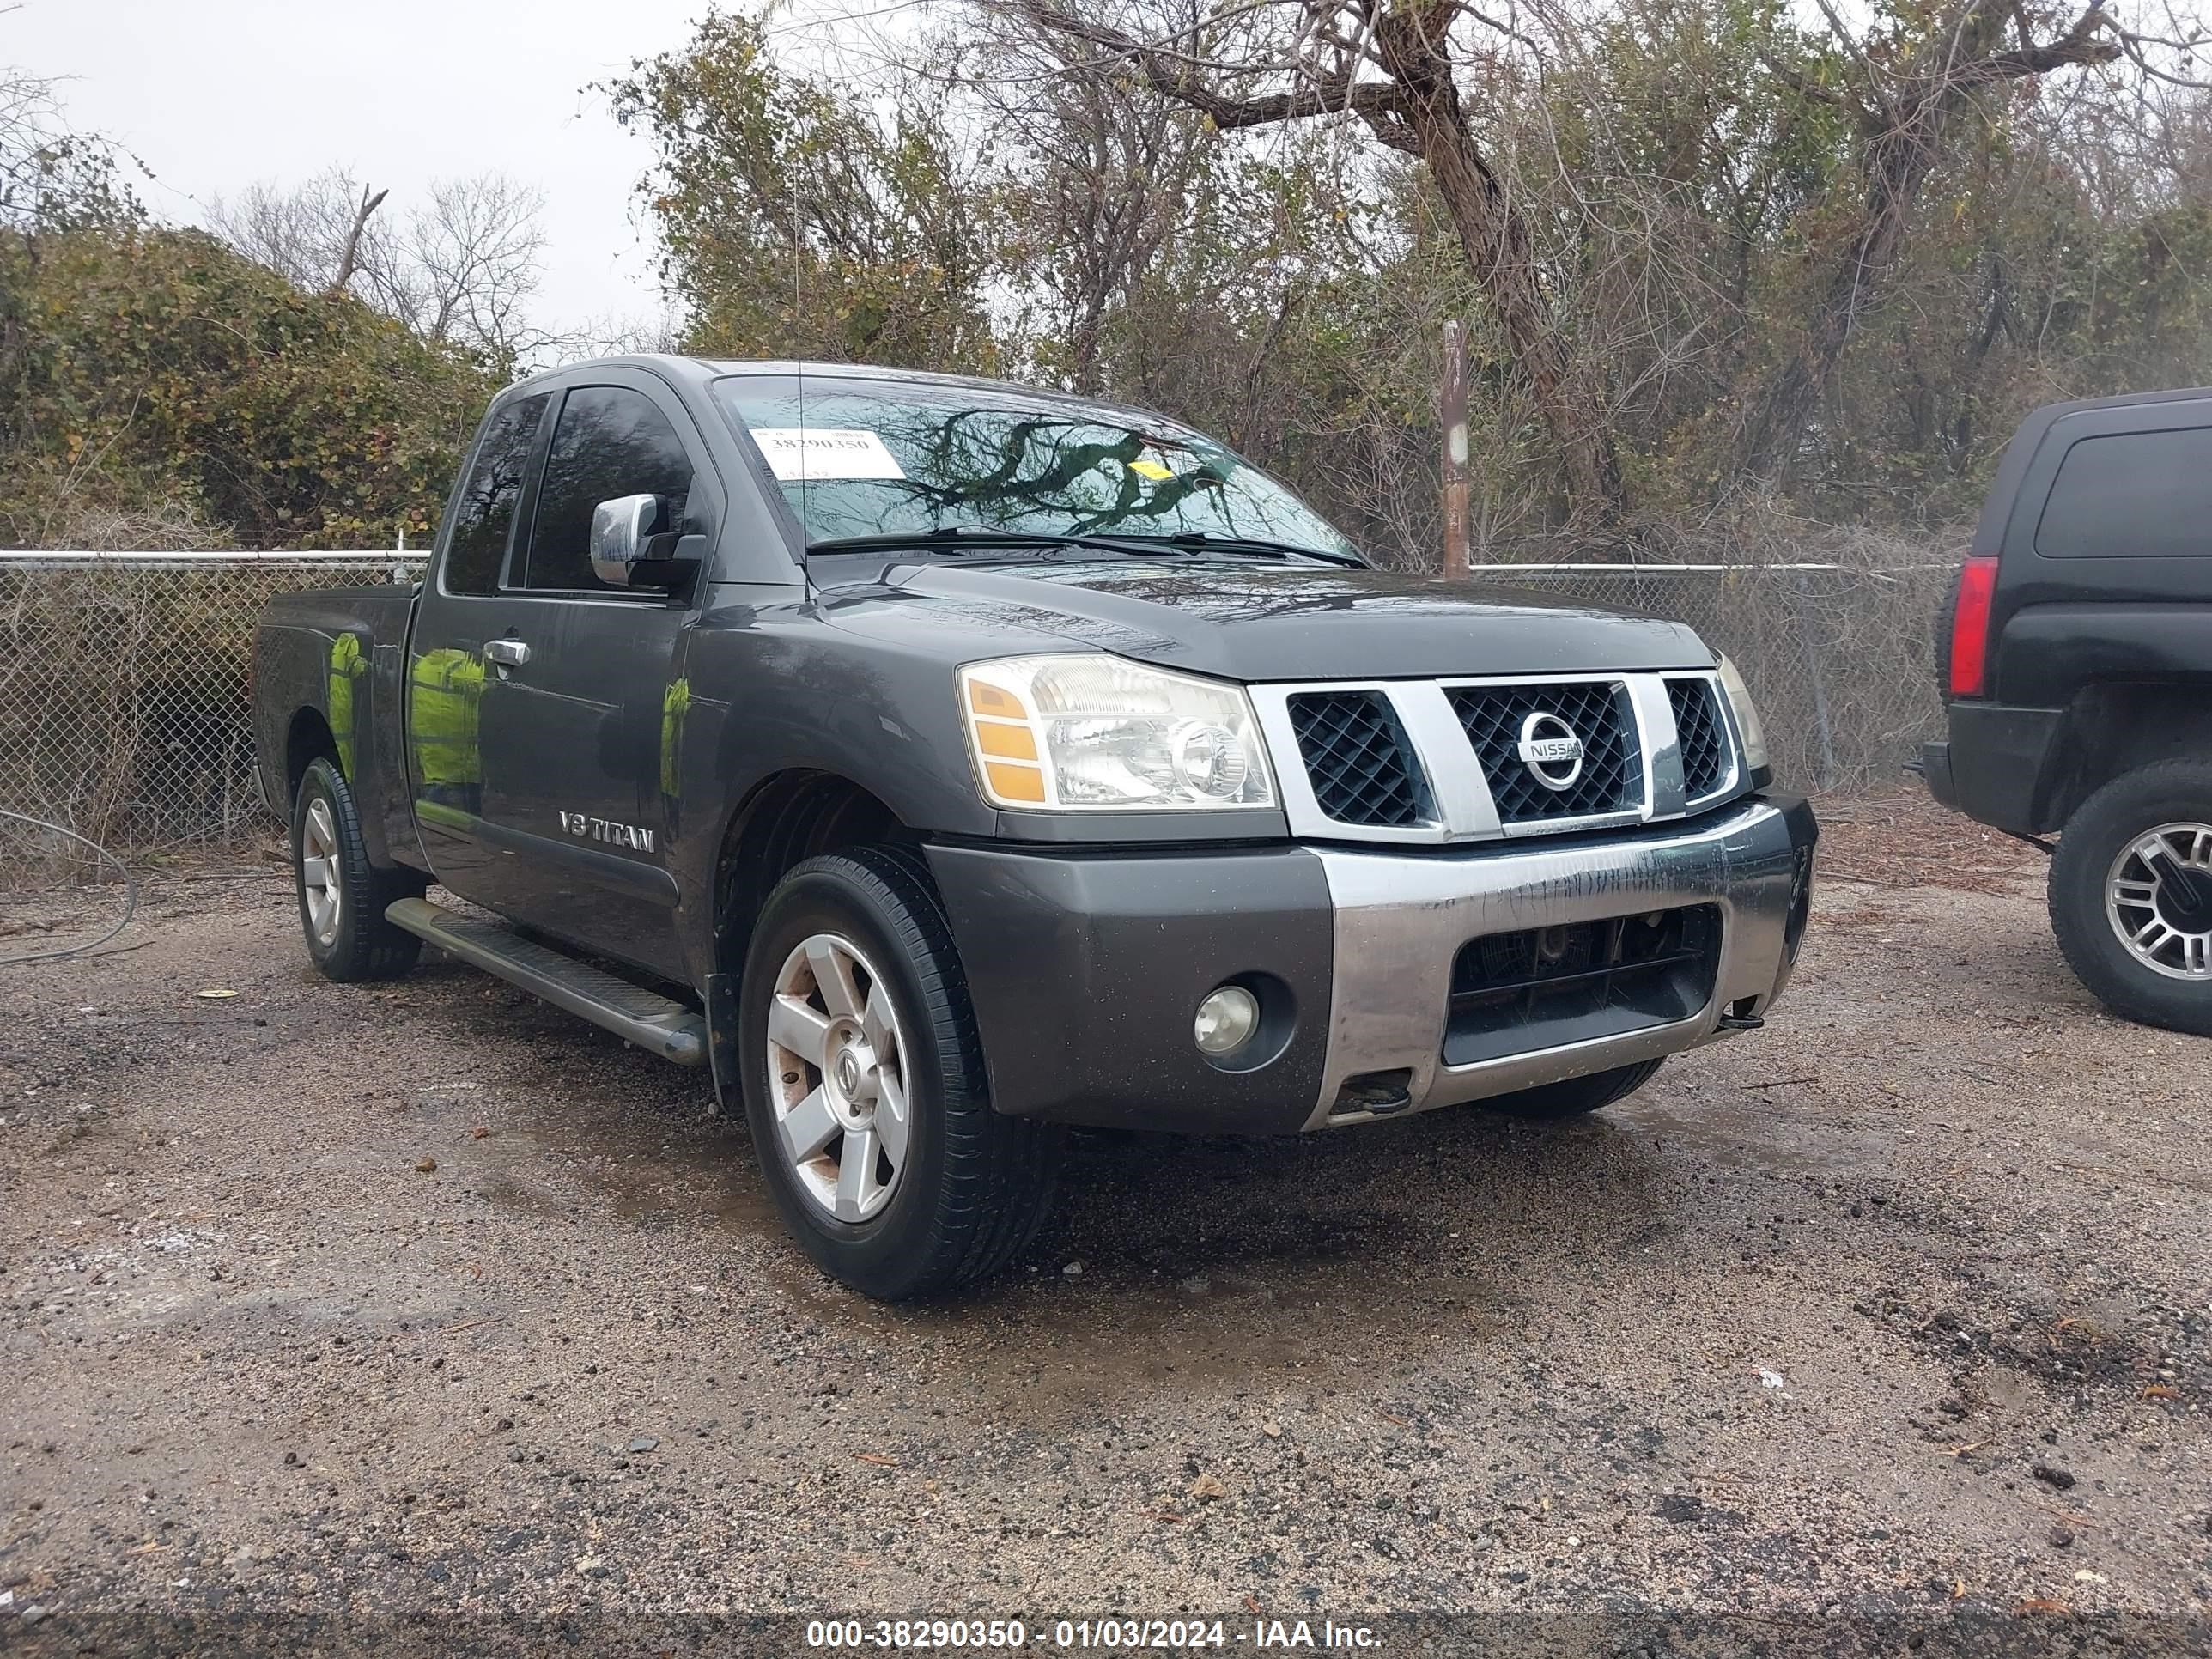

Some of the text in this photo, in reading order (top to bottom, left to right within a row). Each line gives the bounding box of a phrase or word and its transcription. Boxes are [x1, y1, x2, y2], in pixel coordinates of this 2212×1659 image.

[772, 439, 870, 451] 38290350
[1530, 741, 1581, 757] NISSAN
[558, 811, 655, 853] V8 TITAN
